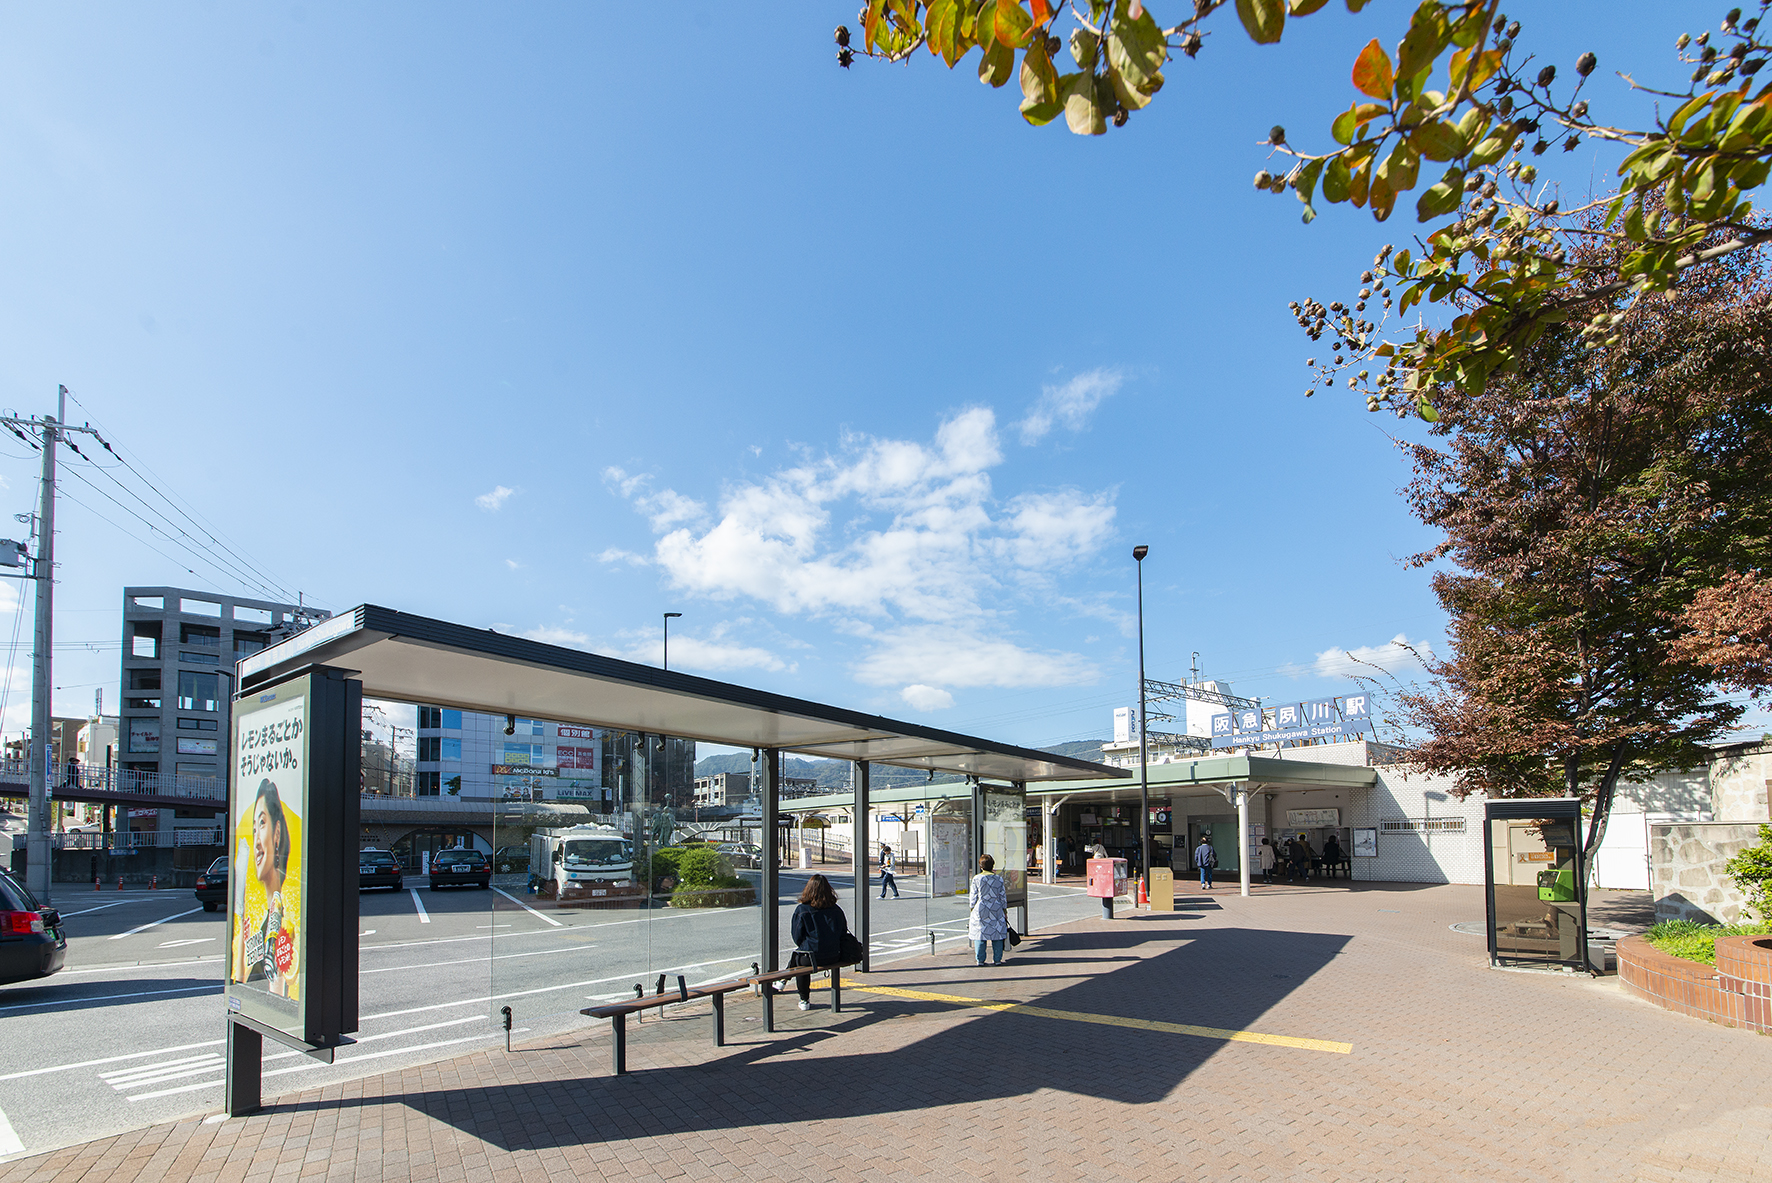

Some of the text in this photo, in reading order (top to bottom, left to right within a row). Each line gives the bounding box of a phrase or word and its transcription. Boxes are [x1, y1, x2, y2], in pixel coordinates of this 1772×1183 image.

[1214, 696, 1365, 732] 阪急夙川駅
[241, 717, 303, 750] レモンまるごとか
[1232, 725, 1342, 744] Hankyu Shukugawa Station
[241, 747, 298, 777] そうじゃないか。
